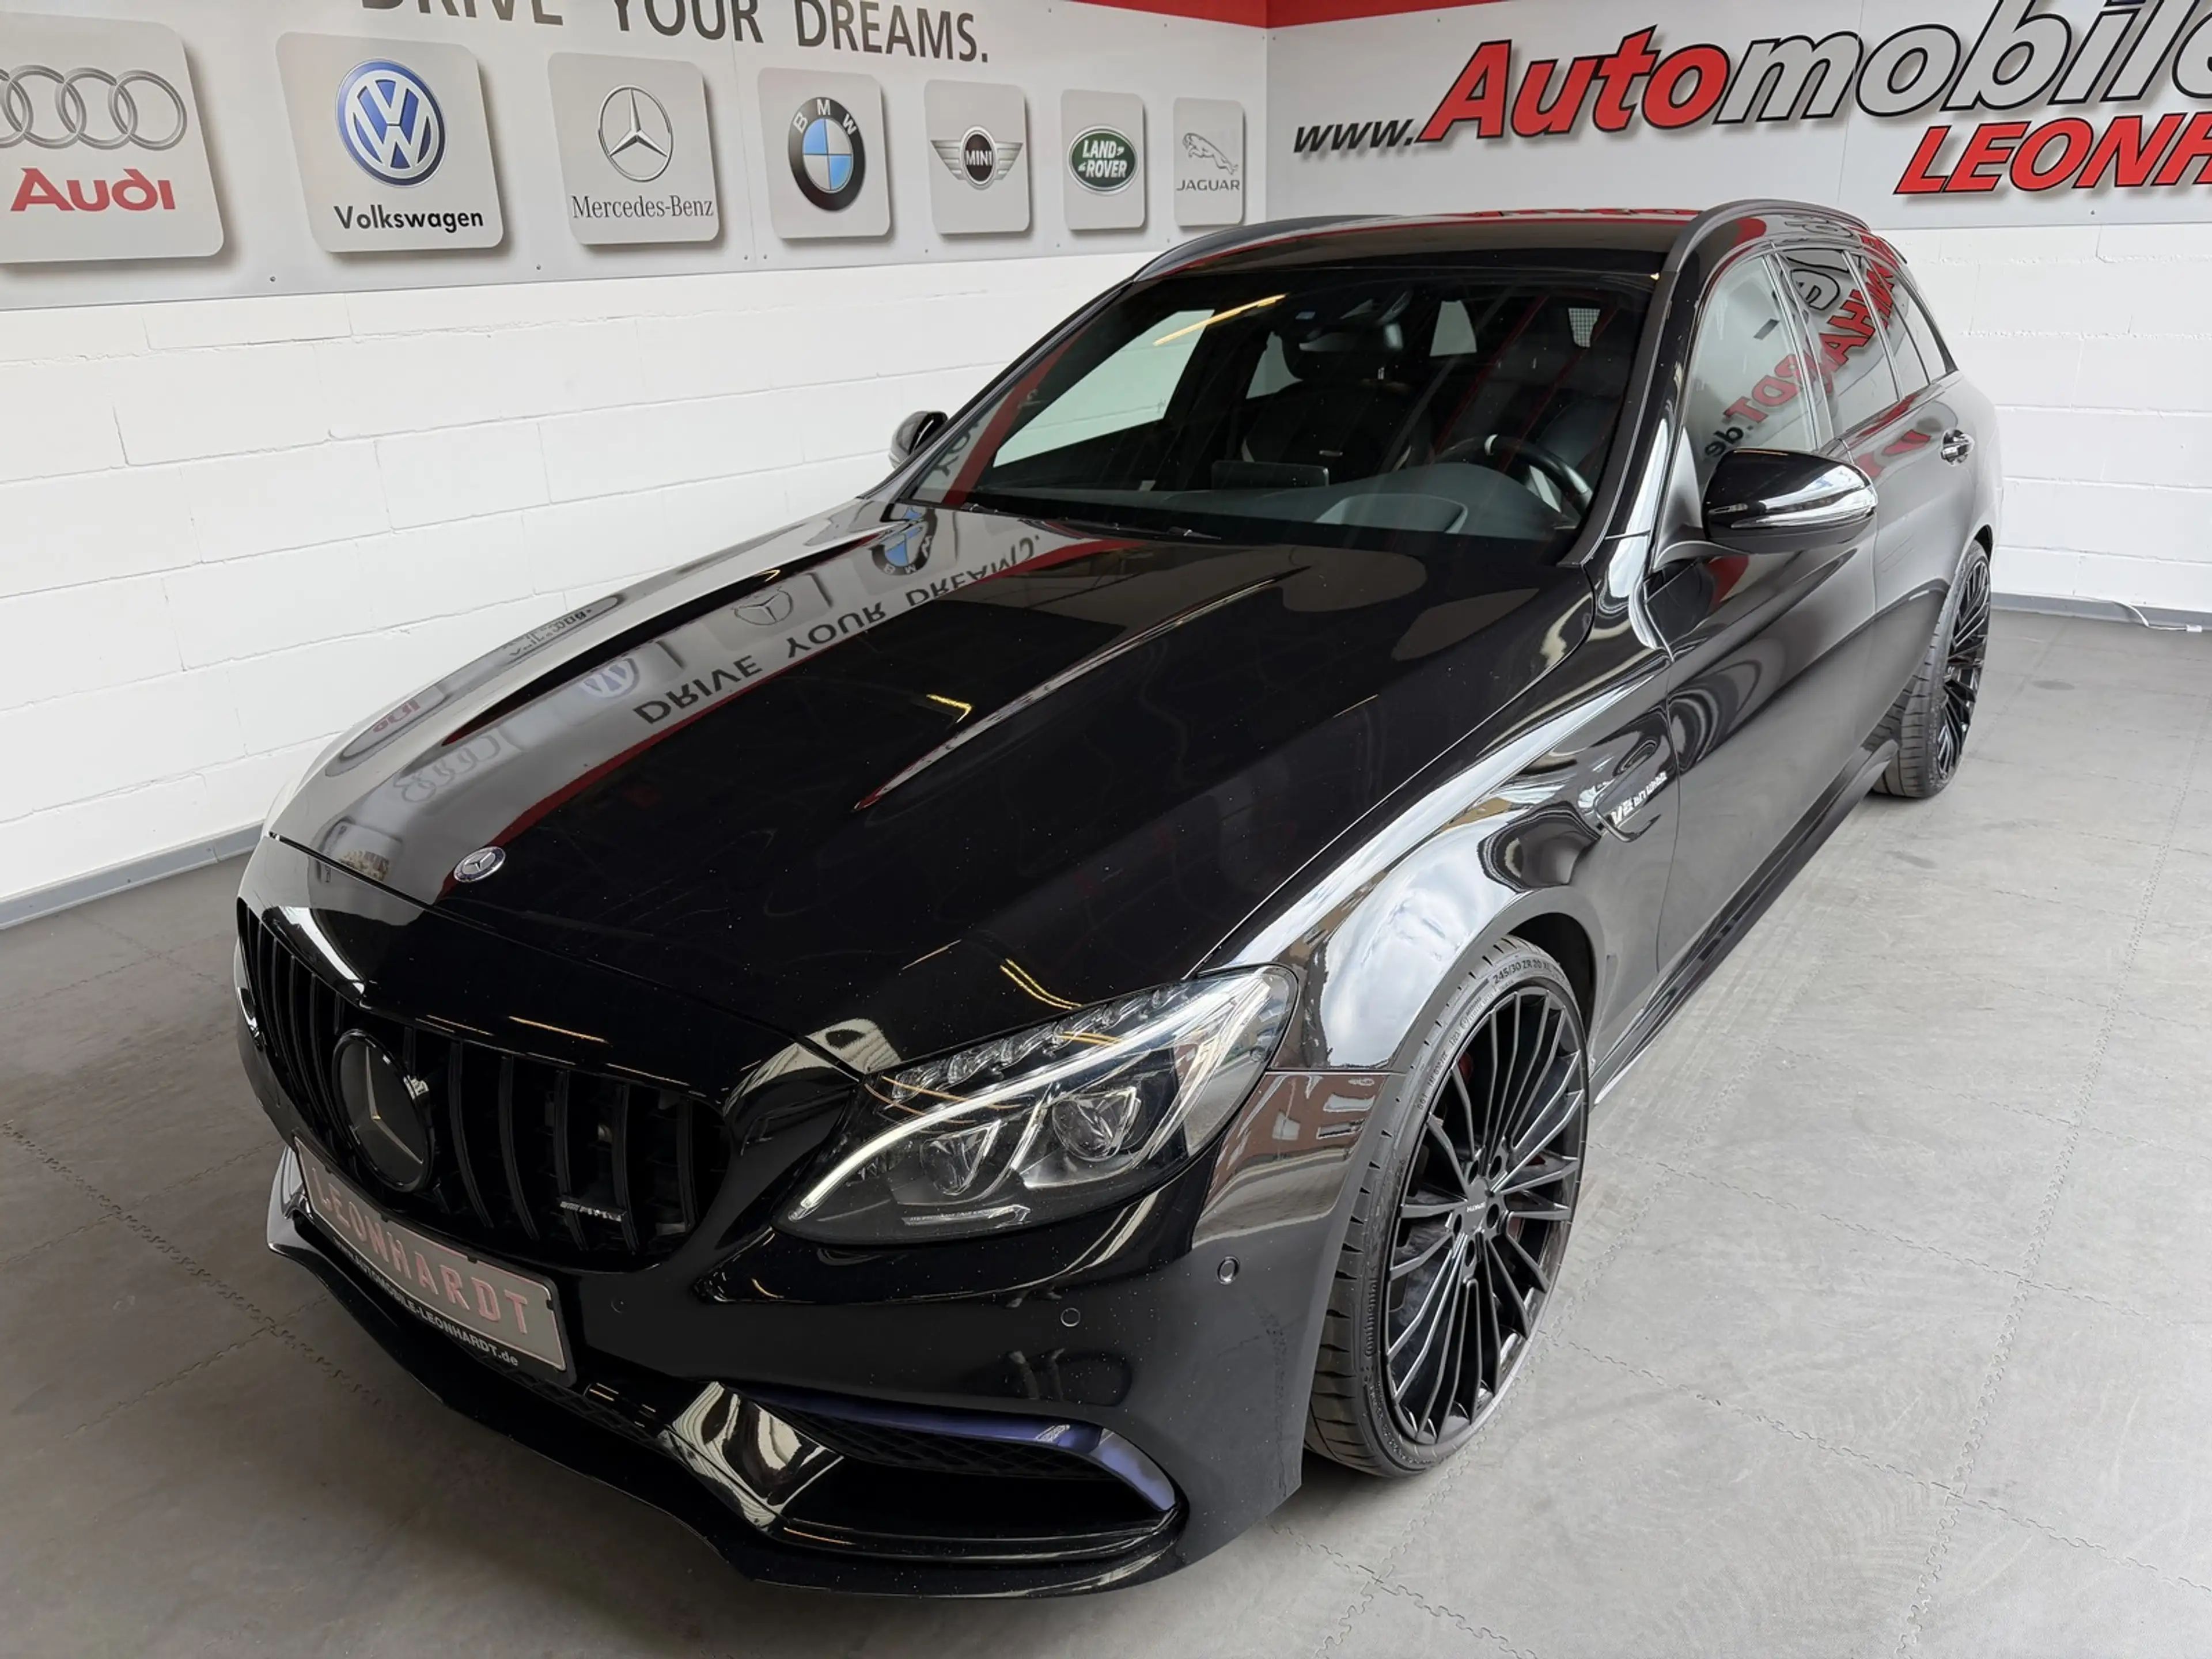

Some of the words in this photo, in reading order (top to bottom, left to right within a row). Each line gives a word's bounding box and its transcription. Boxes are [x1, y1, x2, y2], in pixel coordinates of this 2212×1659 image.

[794, 0, 988, 63] DREAMS.
[793, 99, 857, 135] BMW
[965, 149, 993, 166] MINI
[1082, 139, 1117, 159] LAND
[1085, 159, 1127, 179] ROVER
[10, 168, 176, 212] Audi
[1176, 179, 1241, 191] JAGUAR
[334, 204, 484, 233] Volkswagen
[571, 195, 714, 219] Mercedes-Benz
[1493, 961, 1522, 984] 245/30
[312, 1166, 528, 1335] LEONHARDT
